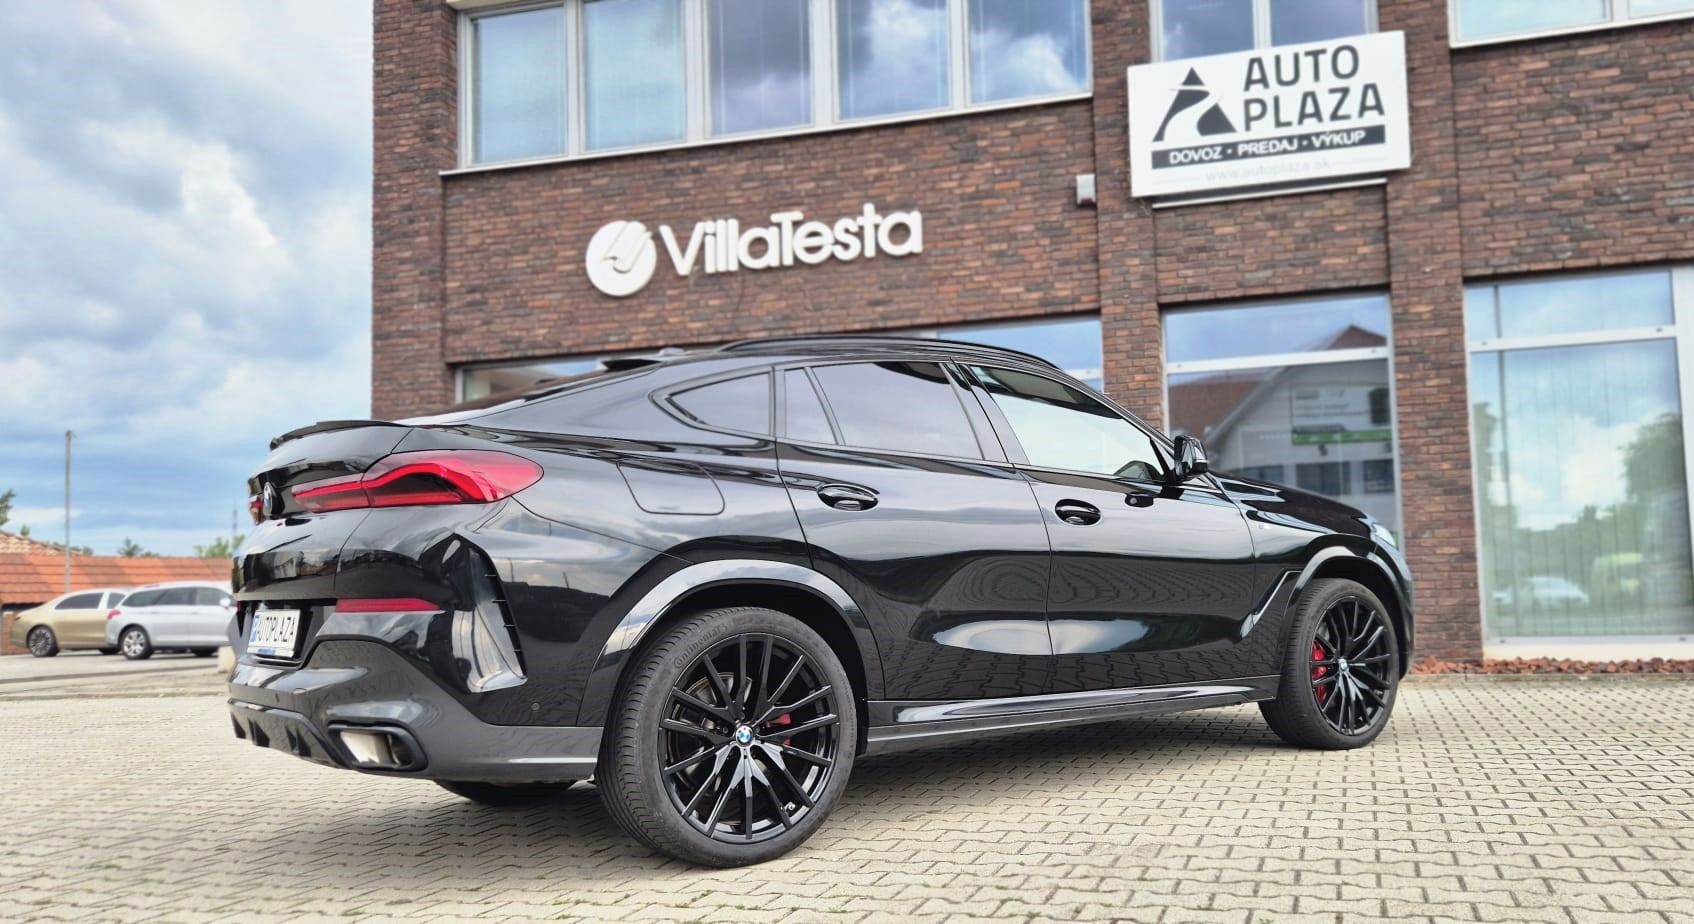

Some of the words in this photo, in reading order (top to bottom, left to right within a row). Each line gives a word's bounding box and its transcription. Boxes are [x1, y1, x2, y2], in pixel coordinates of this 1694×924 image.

[1244, 45, 1359, 92] AUTO
[1244, 82, 1385, 132] PLAZA
[1169, 146, 1222, 165] DOVOZ
[1238, 138, 1298, 157] PREDAJ
[1312, 130, 1365, 149] VÝKUP
[659, 202, 922, 276] VillaTesta
[256, 615, 297, 643] AUTOPLAZA
